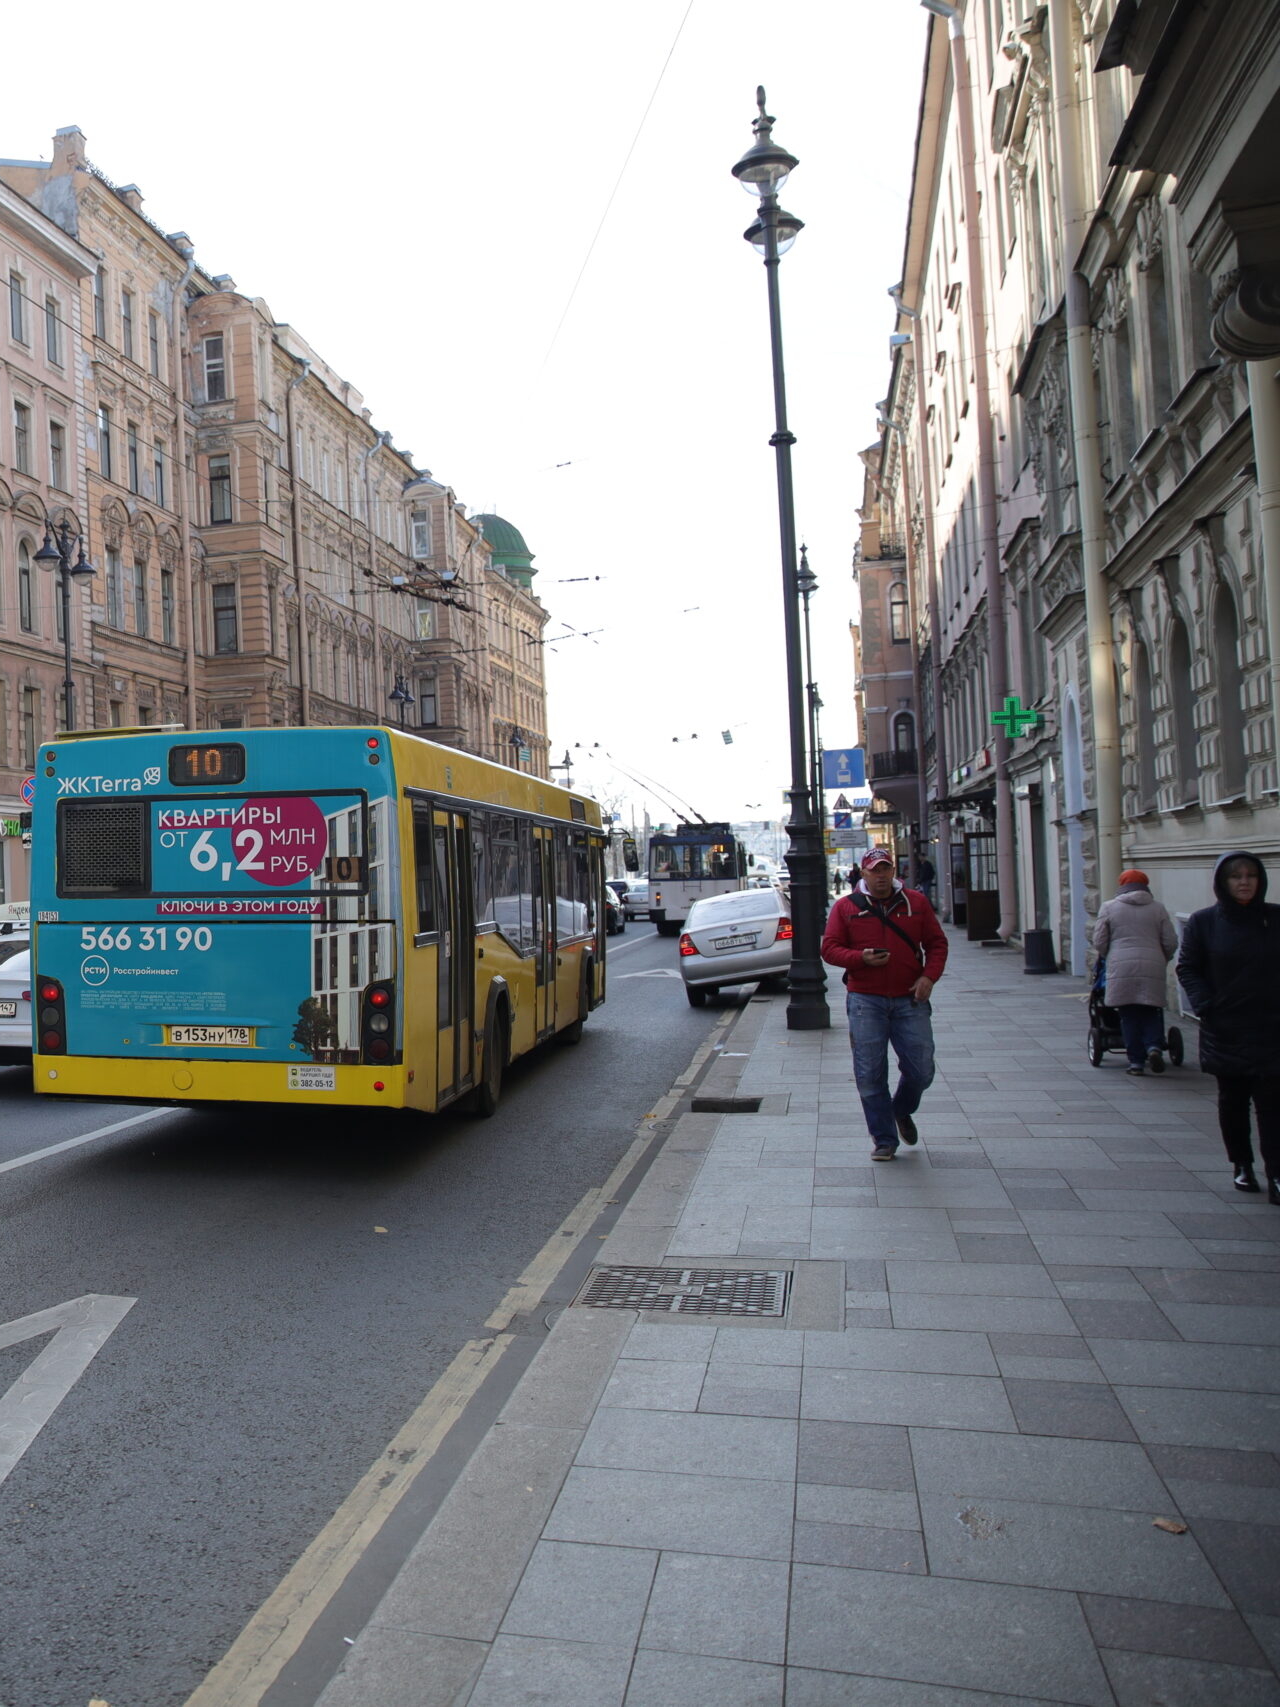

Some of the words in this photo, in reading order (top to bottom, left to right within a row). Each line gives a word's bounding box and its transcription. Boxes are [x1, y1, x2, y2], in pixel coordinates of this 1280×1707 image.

[186, 748, 222, 777] 10
[158, 806, 281, 828] КВАРТИРЫ
[160, 831, 188, 848] ОТ
[189, 829, 265, 881] 6,2
[270, 828, 316, 845] МЛН
[271, 855, 314, 873] РУБ.
[8, 905, 30, 915] Яндек
[161, 900, 214, 913] КЛЮЧИ
[219, 900, 228, 912] В
[232, 900, 273, 912] ЭТОМ
[279, 899, 319, 914] ГОДУ
[80, 926, 132, 951] 566
[138, 926, 167, 951] 31
[175, 926, 213, 951] 90
[113, 966, 179, 976] Росстройинвест
[175, 1028, 224, 1042] В153НУ
[227, 1028, 246, 1039] 178
[300, 1079, 333, 1088] 382-05-12
